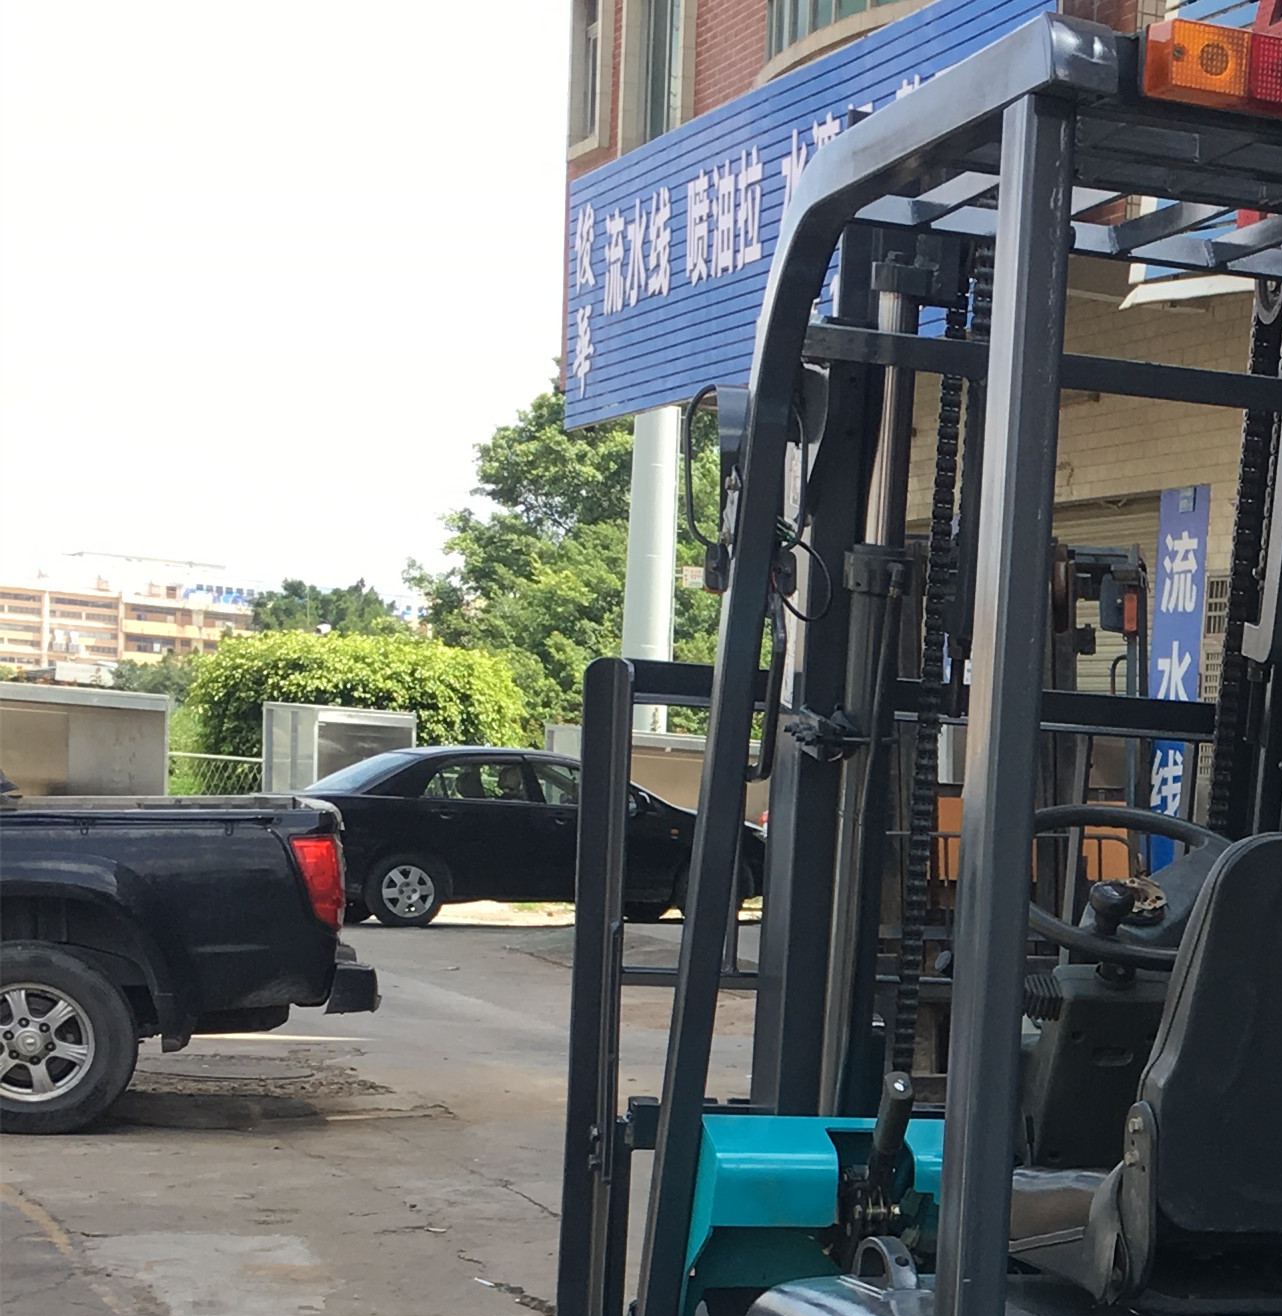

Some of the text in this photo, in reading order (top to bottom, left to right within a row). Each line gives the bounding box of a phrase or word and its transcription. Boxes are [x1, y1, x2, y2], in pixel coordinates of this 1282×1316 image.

[603, 146, 762, 316] 流水线 喷油拉
